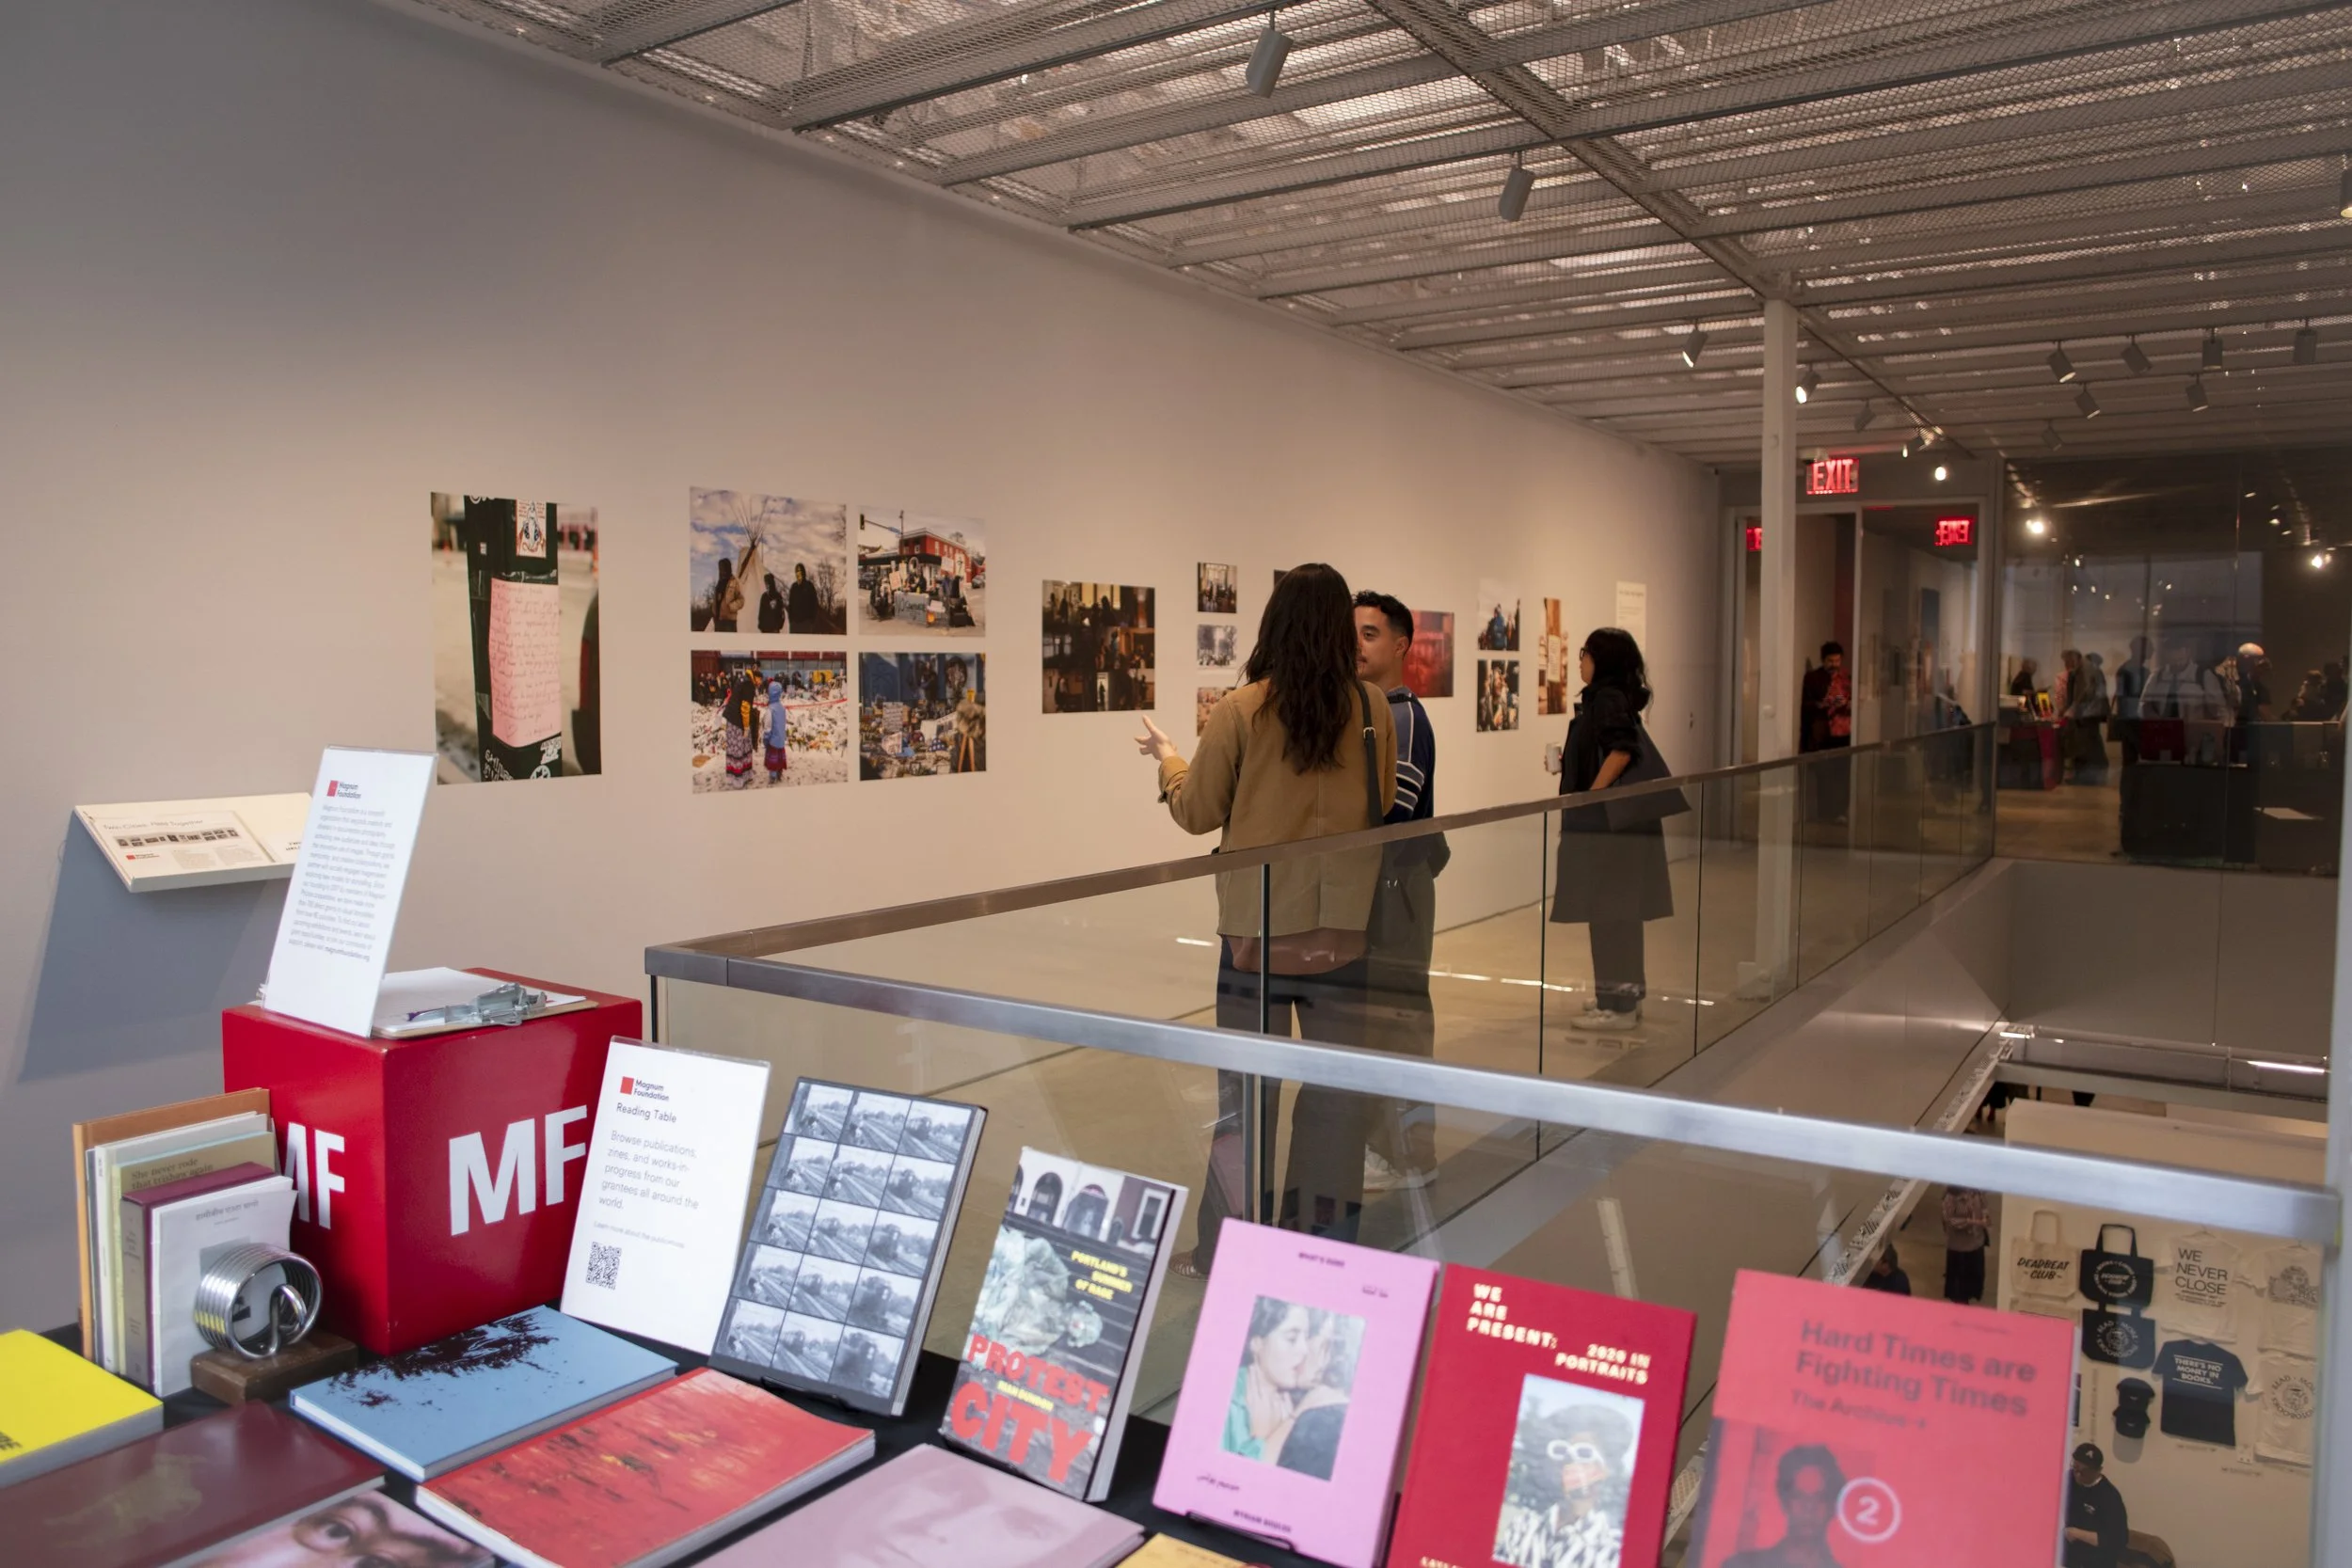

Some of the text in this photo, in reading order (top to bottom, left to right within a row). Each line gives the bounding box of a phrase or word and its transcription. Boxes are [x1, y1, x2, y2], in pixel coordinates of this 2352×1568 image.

[1813, 459, 1853, 491] EXIT
[337, 790, 361, 800] Foundation
[634, 1088, 670, 1101] Foundation
[635, 1080, 664, 1091] Magnum
[616, 1102, 677, 1123] Reading Table
[611, 1130, 697, 1158] Browse publications,
[132, 1157, 199, 1180] She never rode
[632, 1153, 649, 1164] and
[449, 1104, 588, 1237] MF
[604, 1164, 680, 1187] progress from our
[132, 1178, 151, 1189] that
[598, 1196, 624, 1210] world.
[601, 1180, 699, 1210] grantees all around the
[2017, 1257, 2070, 1270] DEADBEAT
[2178, 1247, 2202, 1262] WE
[2029, 1270, 2057, 1280] CLUB
[2176, 1262, 2228, 1281] NEVER
[1473, 1283, 1503, 1303] WE
[2175, 1275, 2227, 1295] CLOSE
[1470, 1300, 1509, 1321] ARE
[1466, 1316, 1558, 1350] PRESENT:
[1586, 1343, 1652, 1369] 2020 IN
[1800, 1319, 2038, 1384] Hard Times are
[966, 1332, 1110, 1414] PROTEST
[1554, 1351, 1649, 1386] PORTRAITS
[2177, 1366, 2207, 1377] MONEY
[2181, 1372, 2214, 1385] BOOKS.
[2207, 1364, 2222, 1372] NO
[1795, 1350, 2029, 1417] Fighting Times
[1791, 1388, 1826, 1411] The
[950, 1381, 1093, 1484] CITY
[1855, 1495, 1880, 1527] 2
